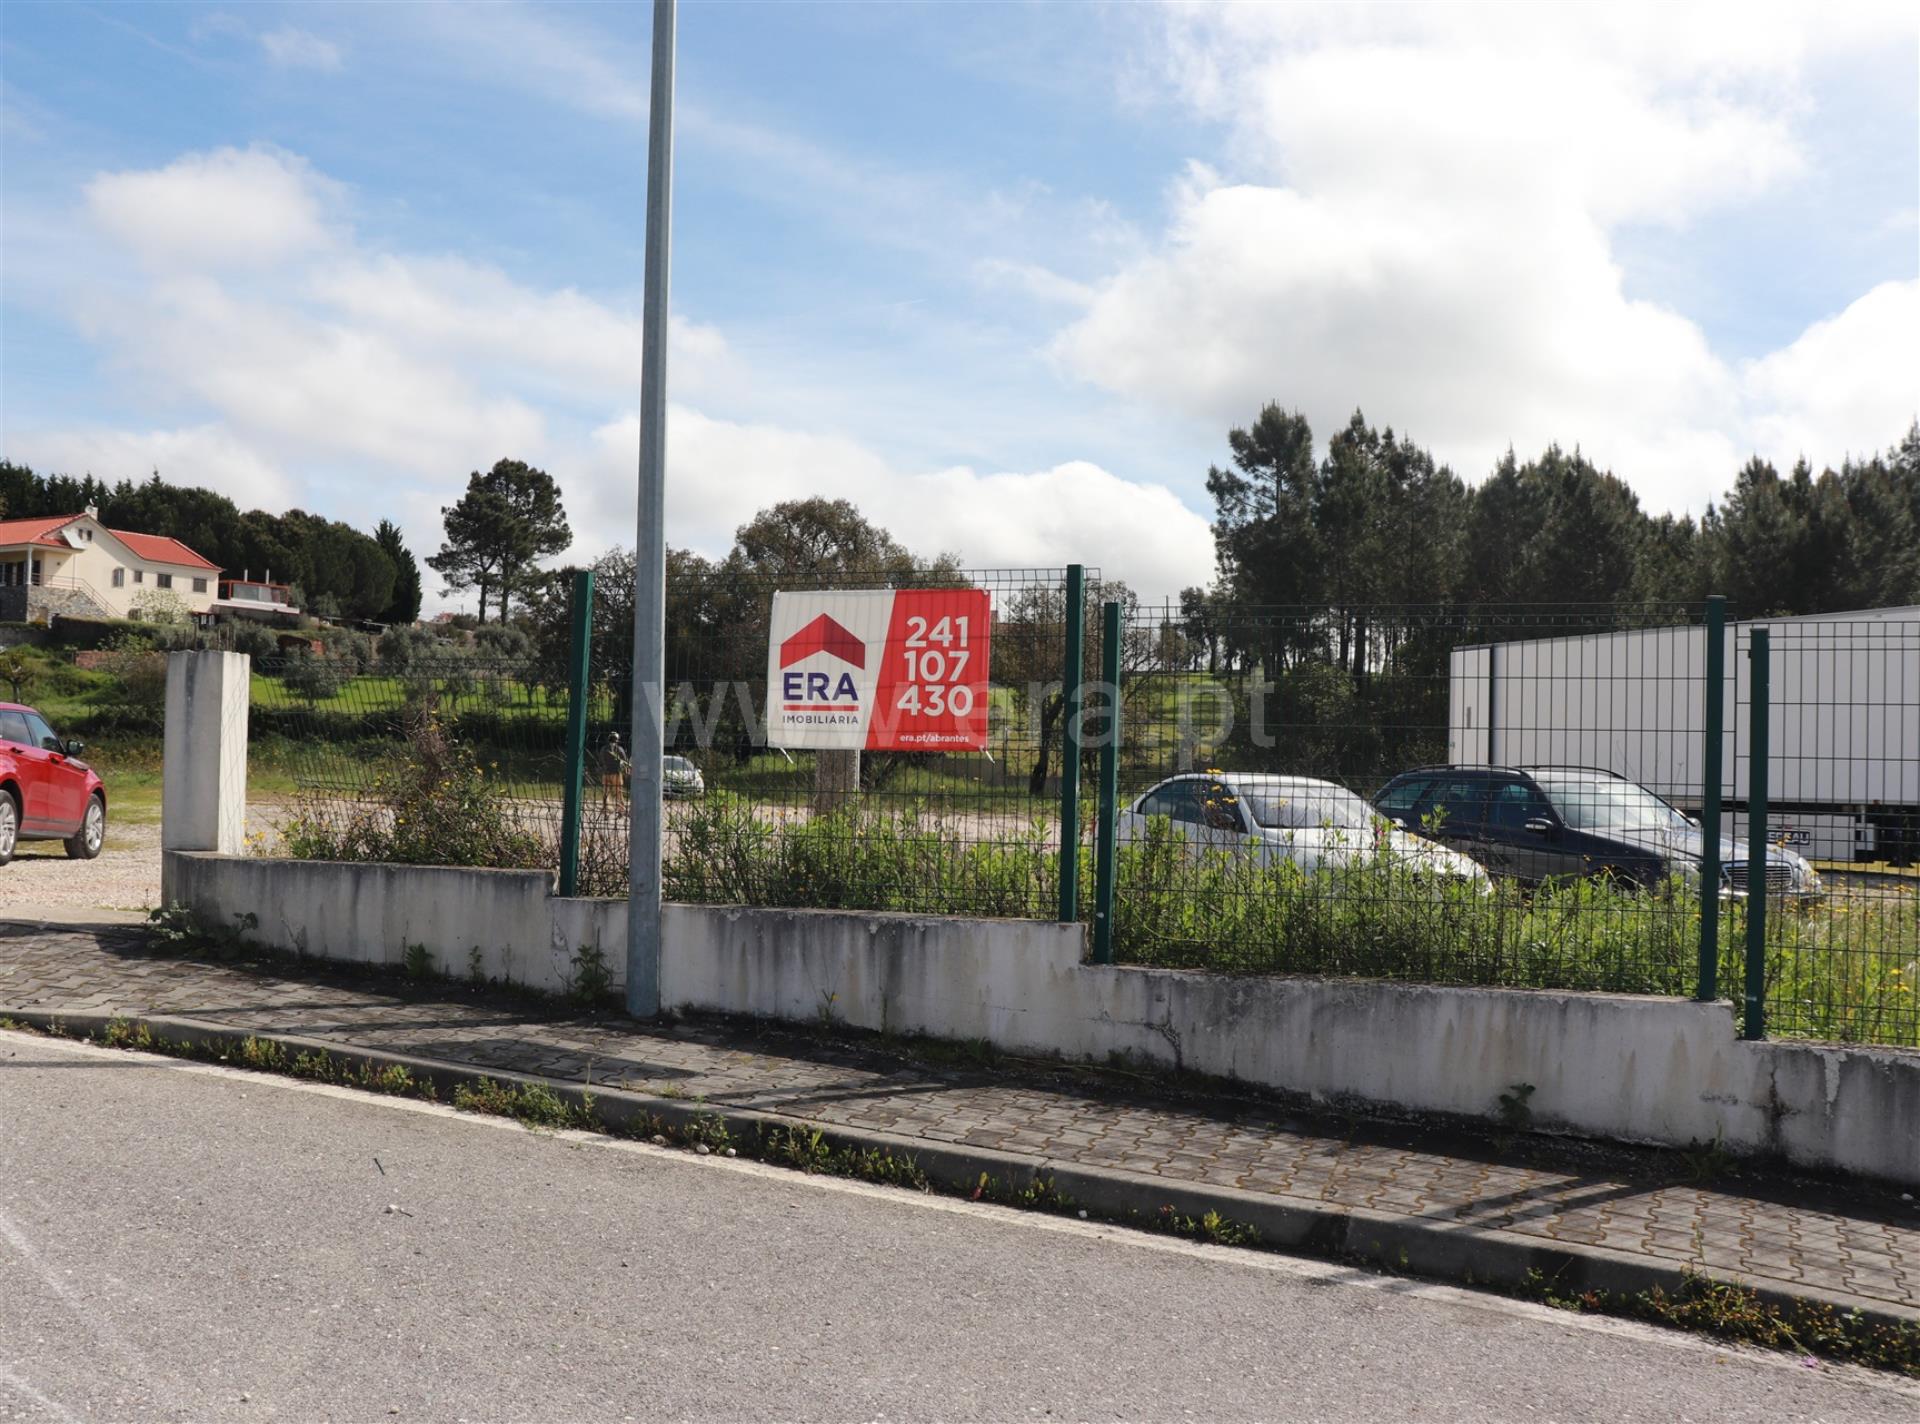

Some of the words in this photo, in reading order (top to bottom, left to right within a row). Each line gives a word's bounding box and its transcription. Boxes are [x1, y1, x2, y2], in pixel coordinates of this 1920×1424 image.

[905, 616, 968, 647] 241
[903, 650, 970, 682] 107
[783, 672, 859, 701] ERA
[896, 684, 974, 717] 430
[900, 733, 969, 743] era.pt/abrantes
